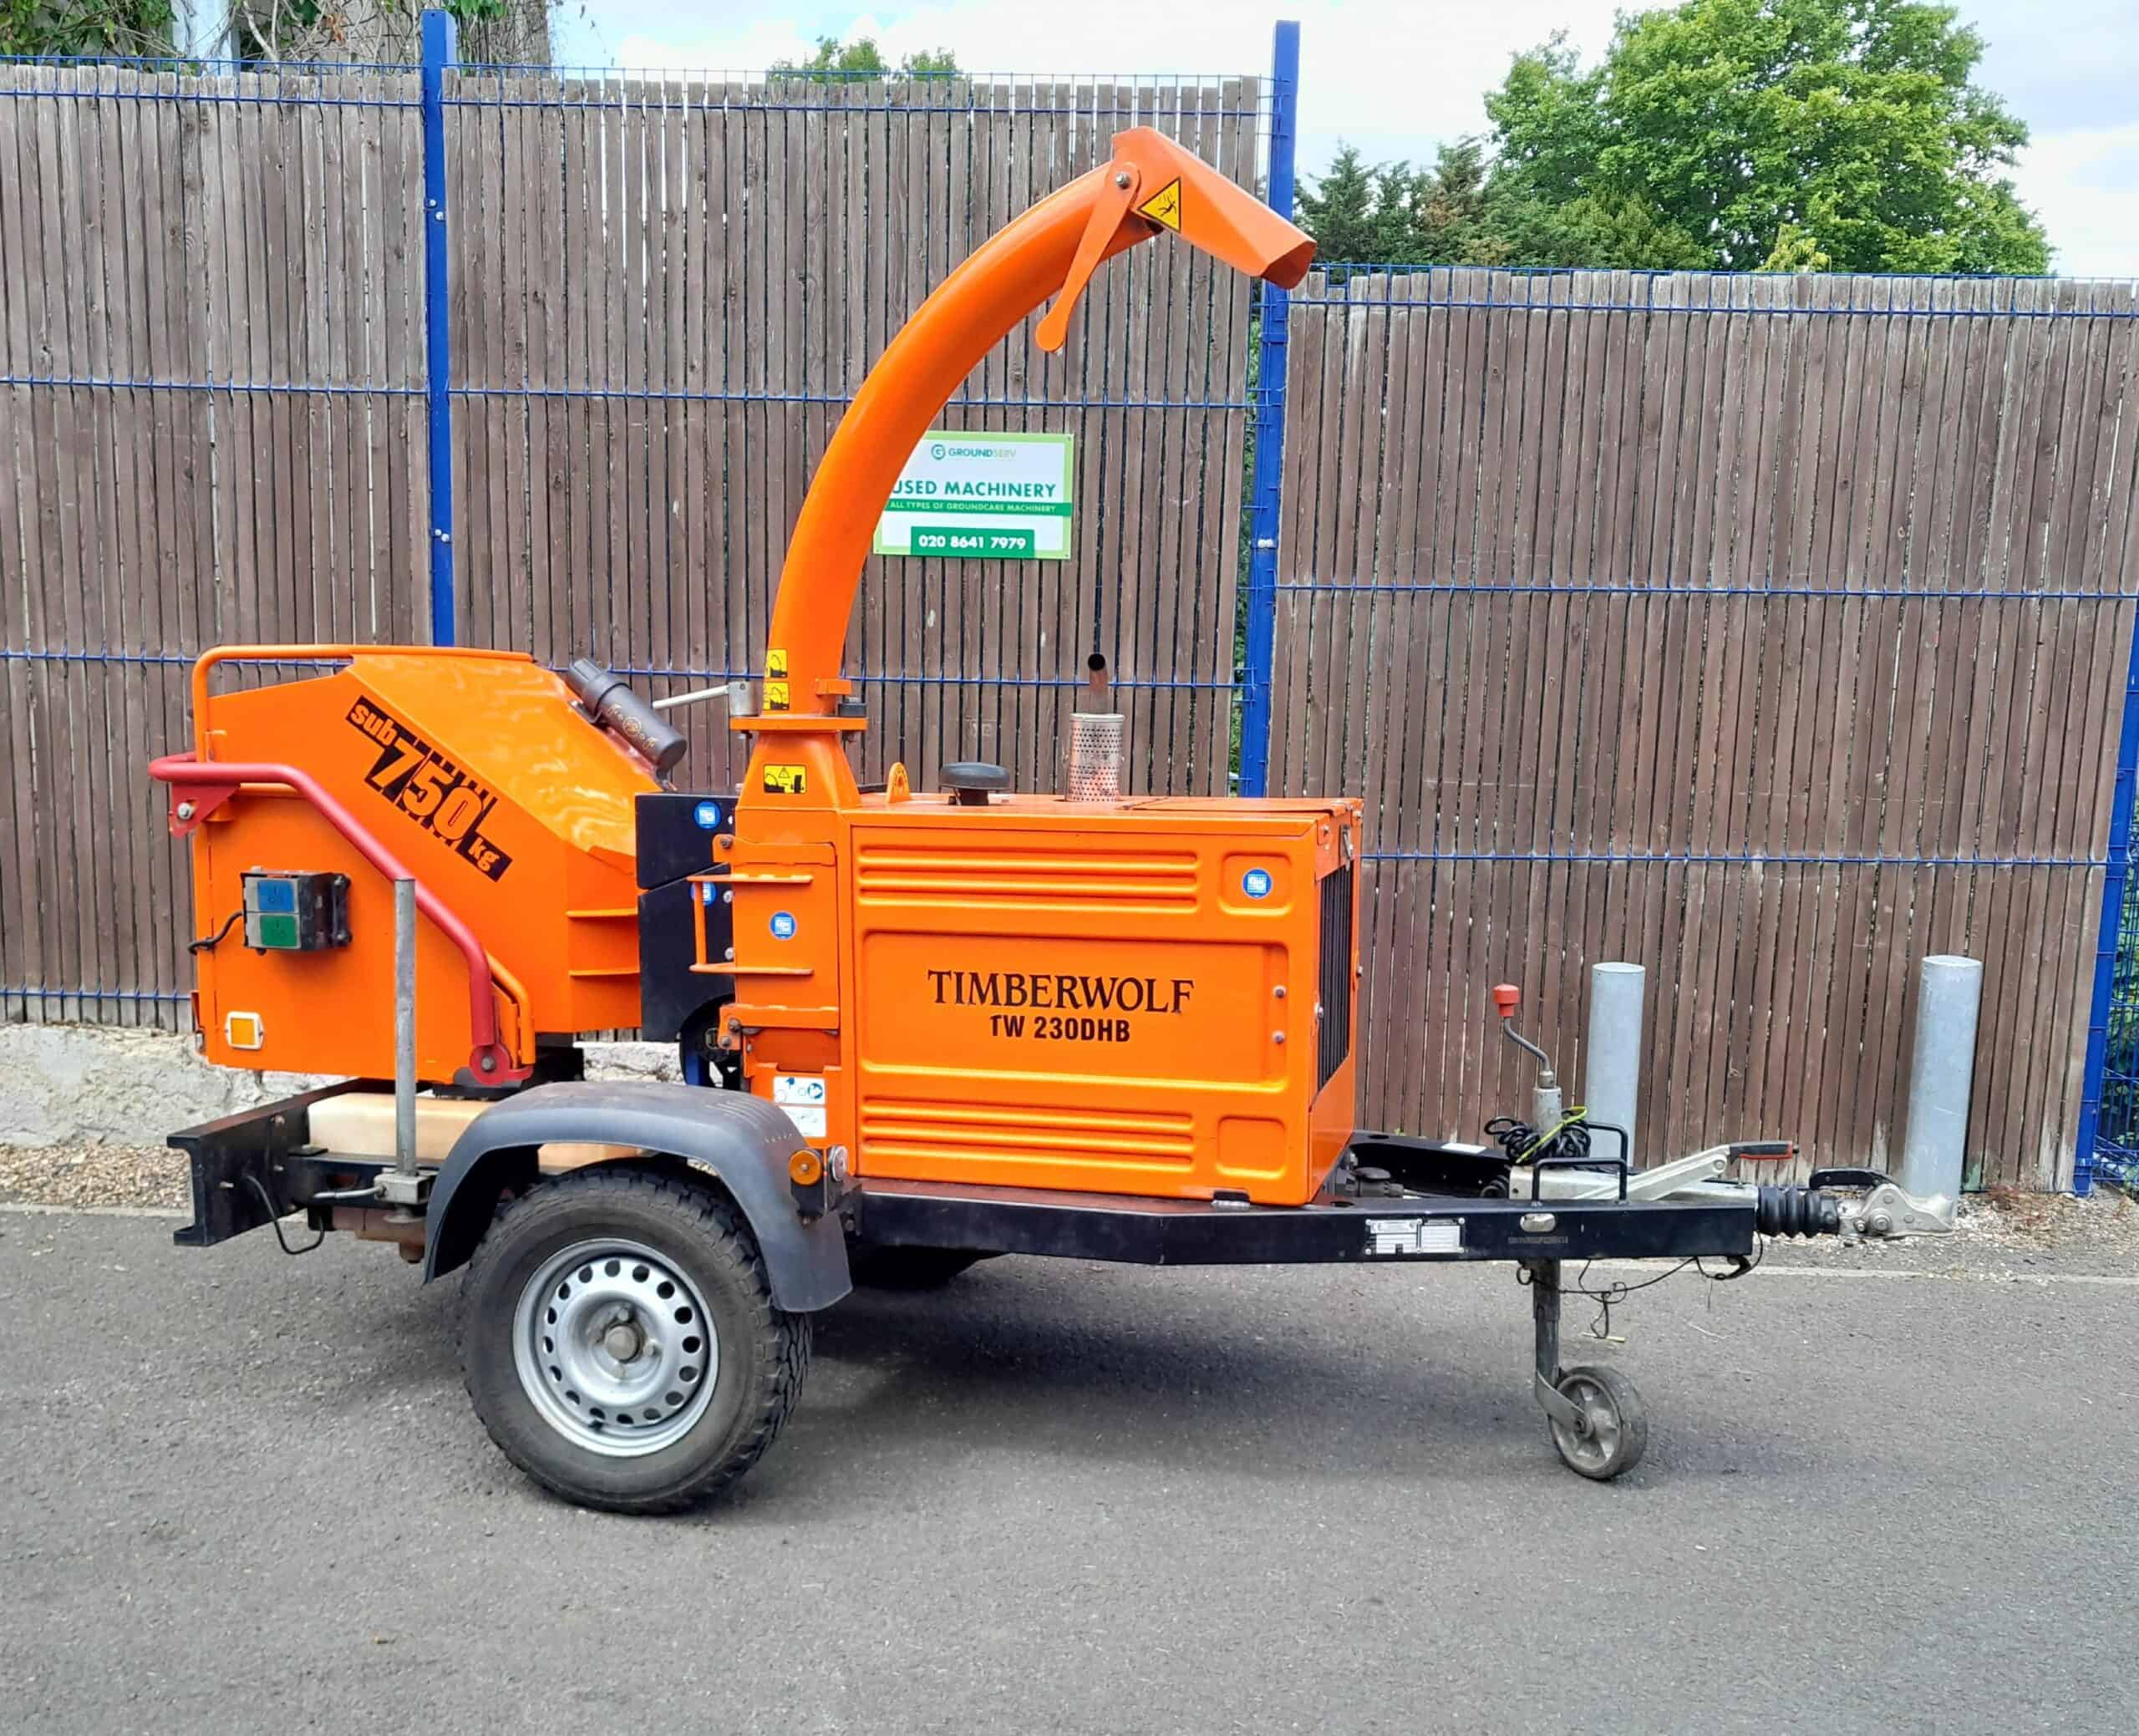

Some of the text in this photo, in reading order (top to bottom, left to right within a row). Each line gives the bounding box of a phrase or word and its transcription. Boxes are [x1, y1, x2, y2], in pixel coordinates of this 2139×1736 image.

[944, 481, 1057, 498] MACHINERY
[907, 501, 930, 510] TYPES
[947, 503, 1004, 512] GROUNDCARE
[1007, 504, 1057, 513] MACHINERY
[918, 535, 1026, 550] 020 8641 7979
[349, 703, 500, 872] sub 750 kg
[927, 969, 1195, 1014] TIMBERWOLF
[989, 1014, 1130, 1043] TW 230DHB
